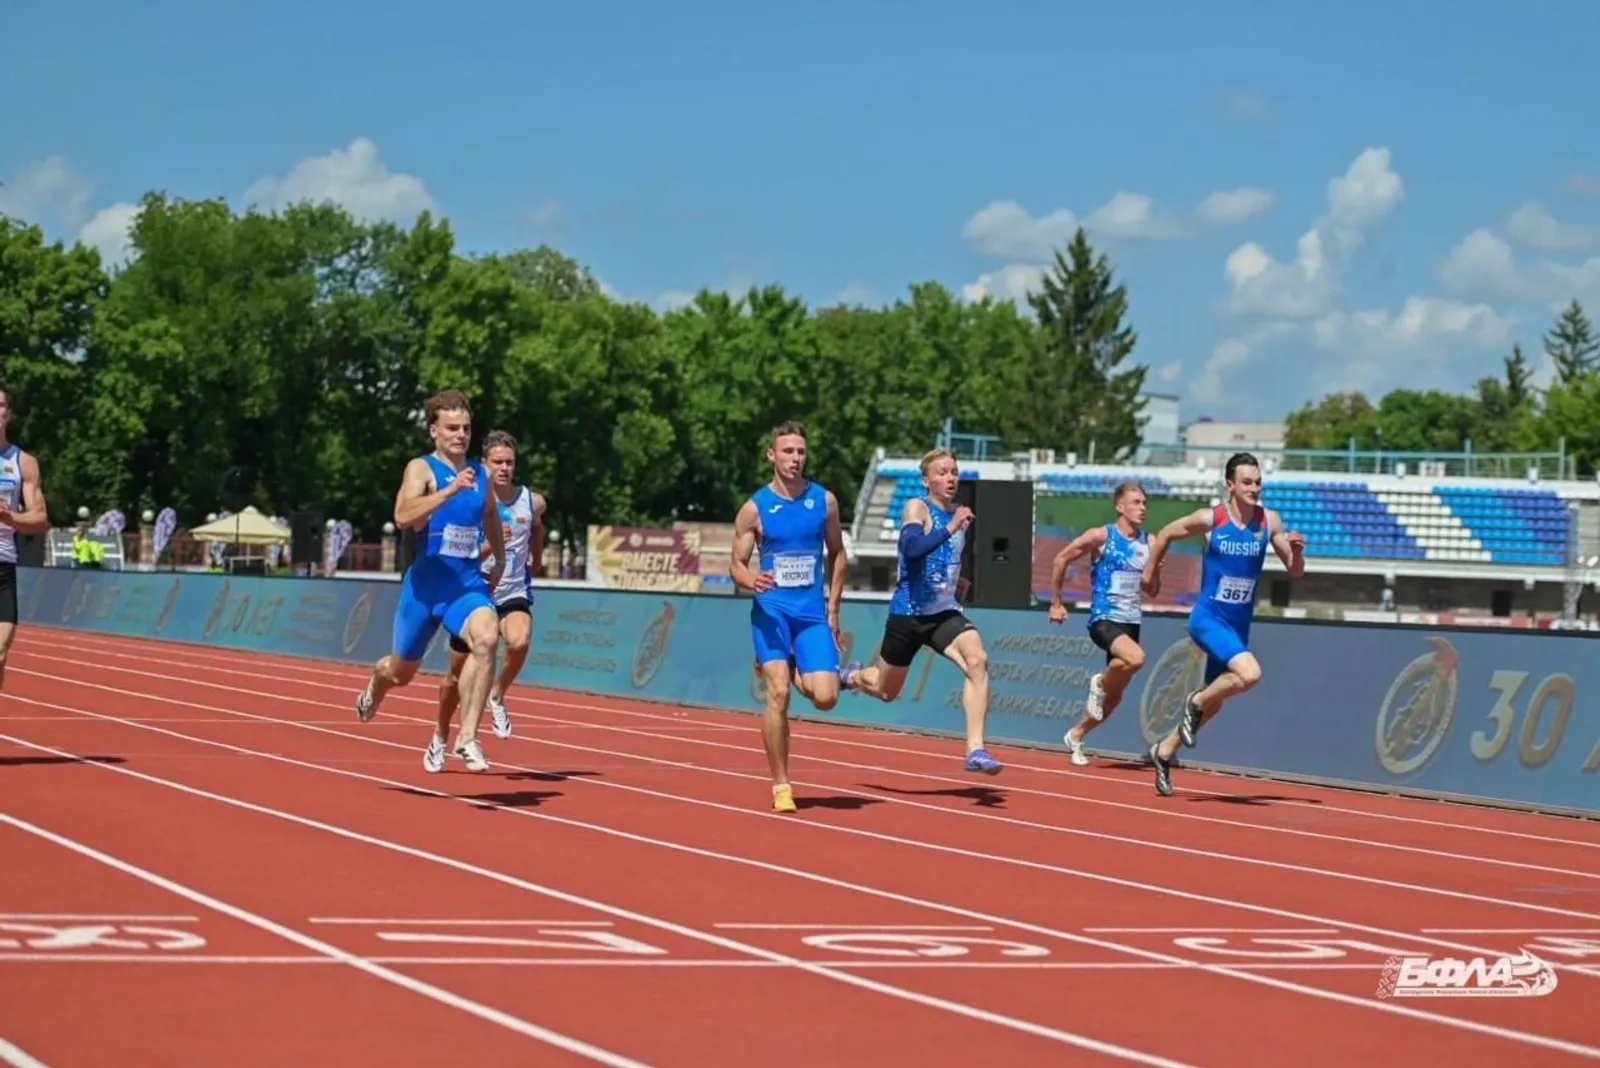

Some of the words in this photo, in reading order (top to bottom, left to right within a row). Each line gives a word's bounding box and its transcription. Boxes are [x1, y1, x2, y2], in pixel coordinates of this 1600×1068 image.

[1220, 540, 1261, 557] RUSSIA
[621, 552, 682, 573] ВМЕСТЕ
[1222, 588, 1250, 601] 367
[1470, 669, 1575, 765] 30
